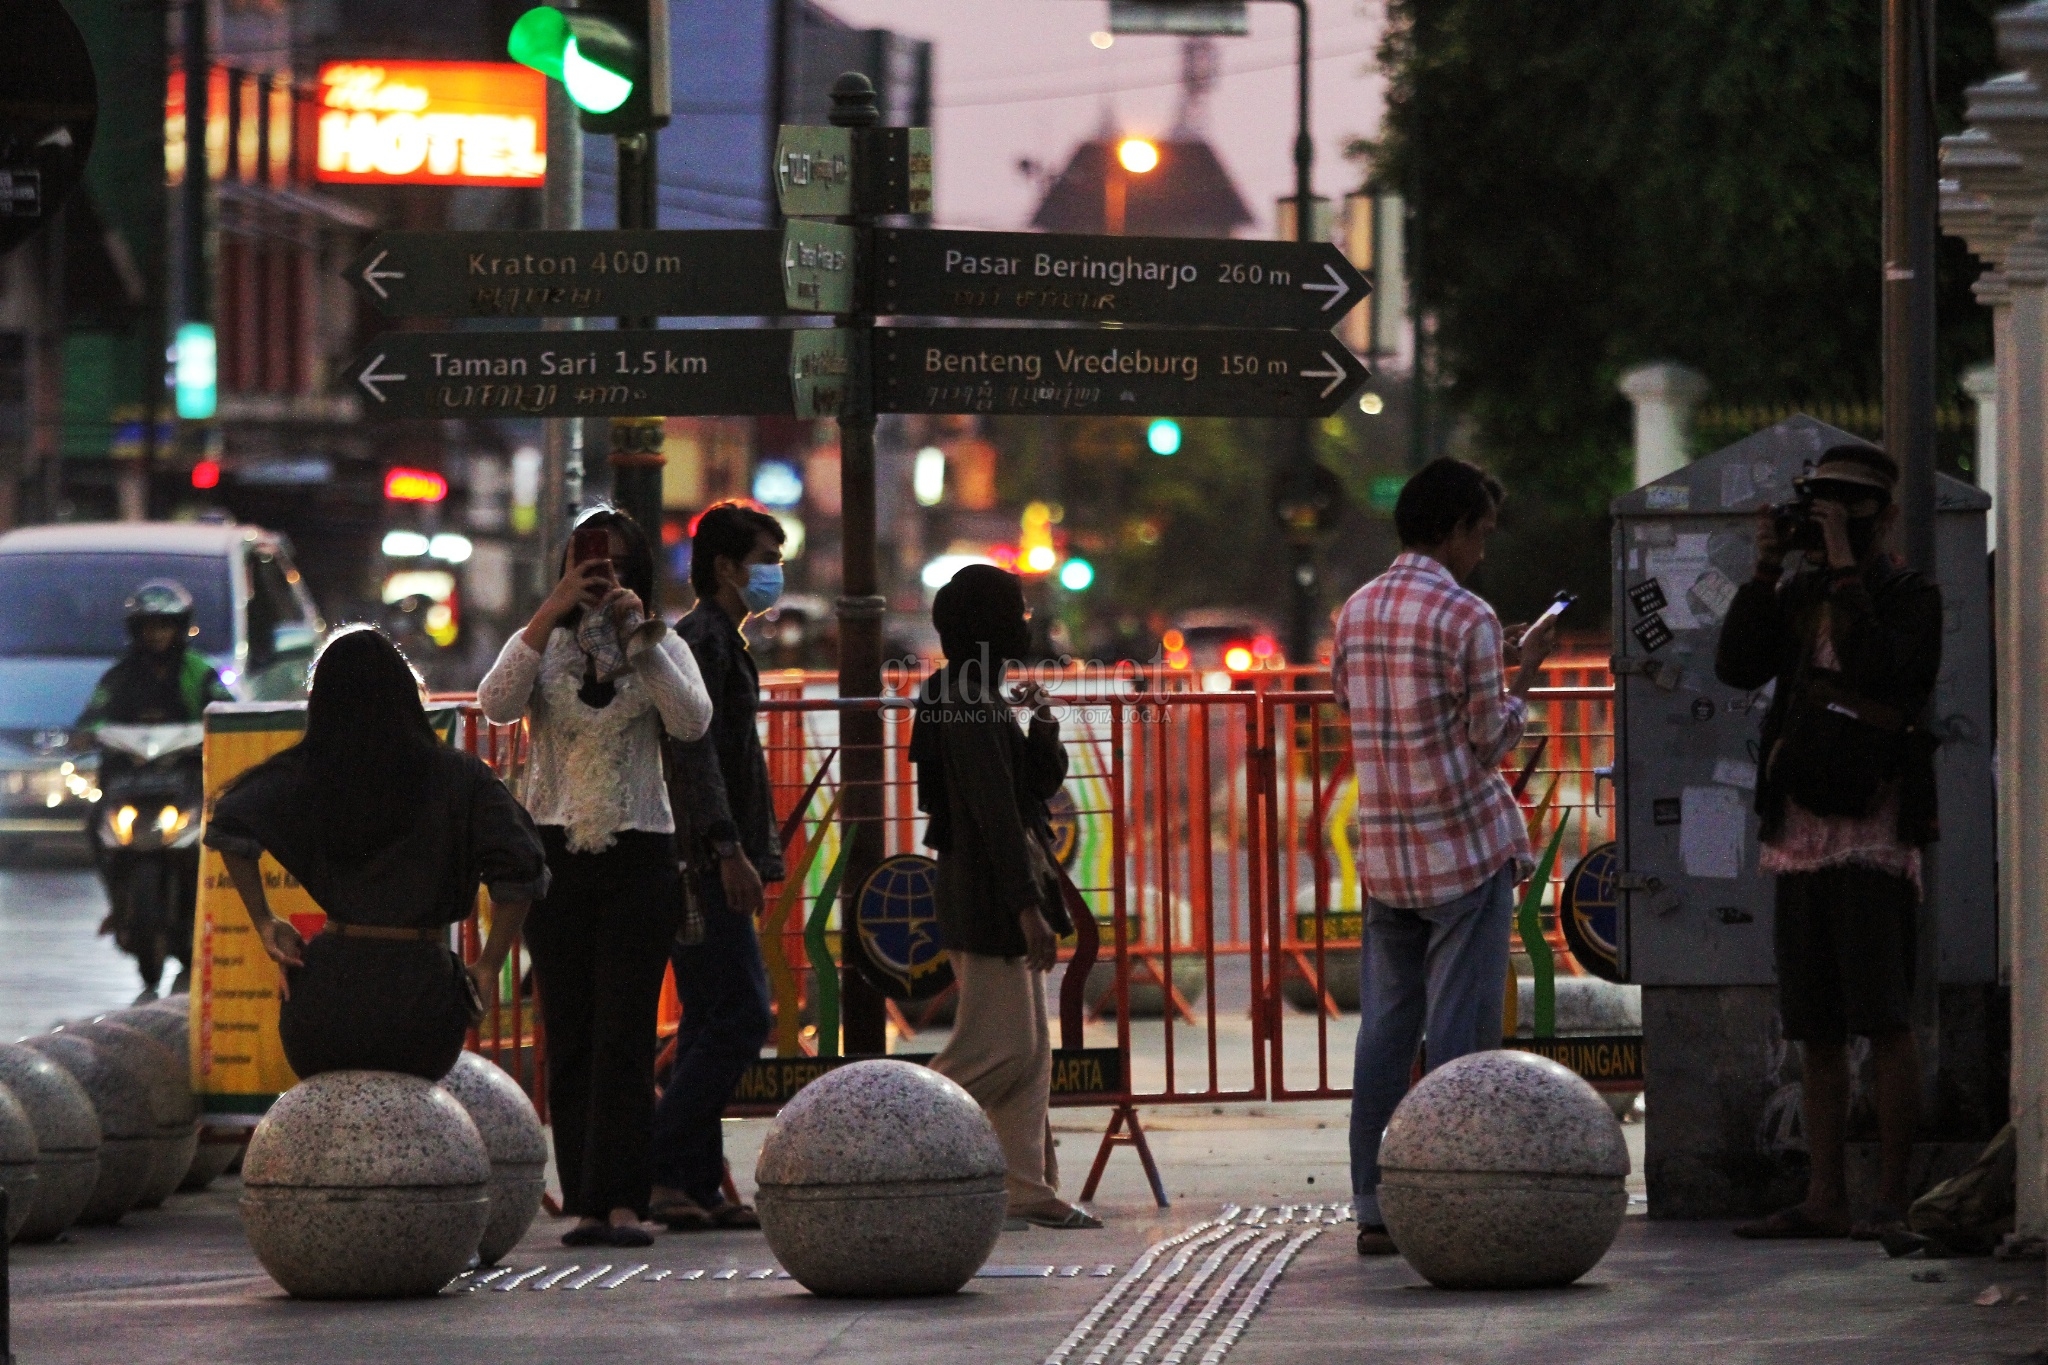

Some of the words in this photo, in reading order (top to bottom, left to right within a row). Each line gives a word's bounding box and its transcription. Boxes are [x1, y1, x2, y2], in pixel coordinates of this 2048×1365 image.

[319, 110, 546, 177] HOTEL
[468, 253, 577, 275] Kraton
[944, 248, 1020, 275] Pasar
[1034, 251, 1198, 291] Beringharjo
[430, 351, 528, 376] Taman
[539, 350, 597, 376] Sari
[924, 347, 1043, 383] Benteng
[1056, 347, 1199, 383] Vredeburg
